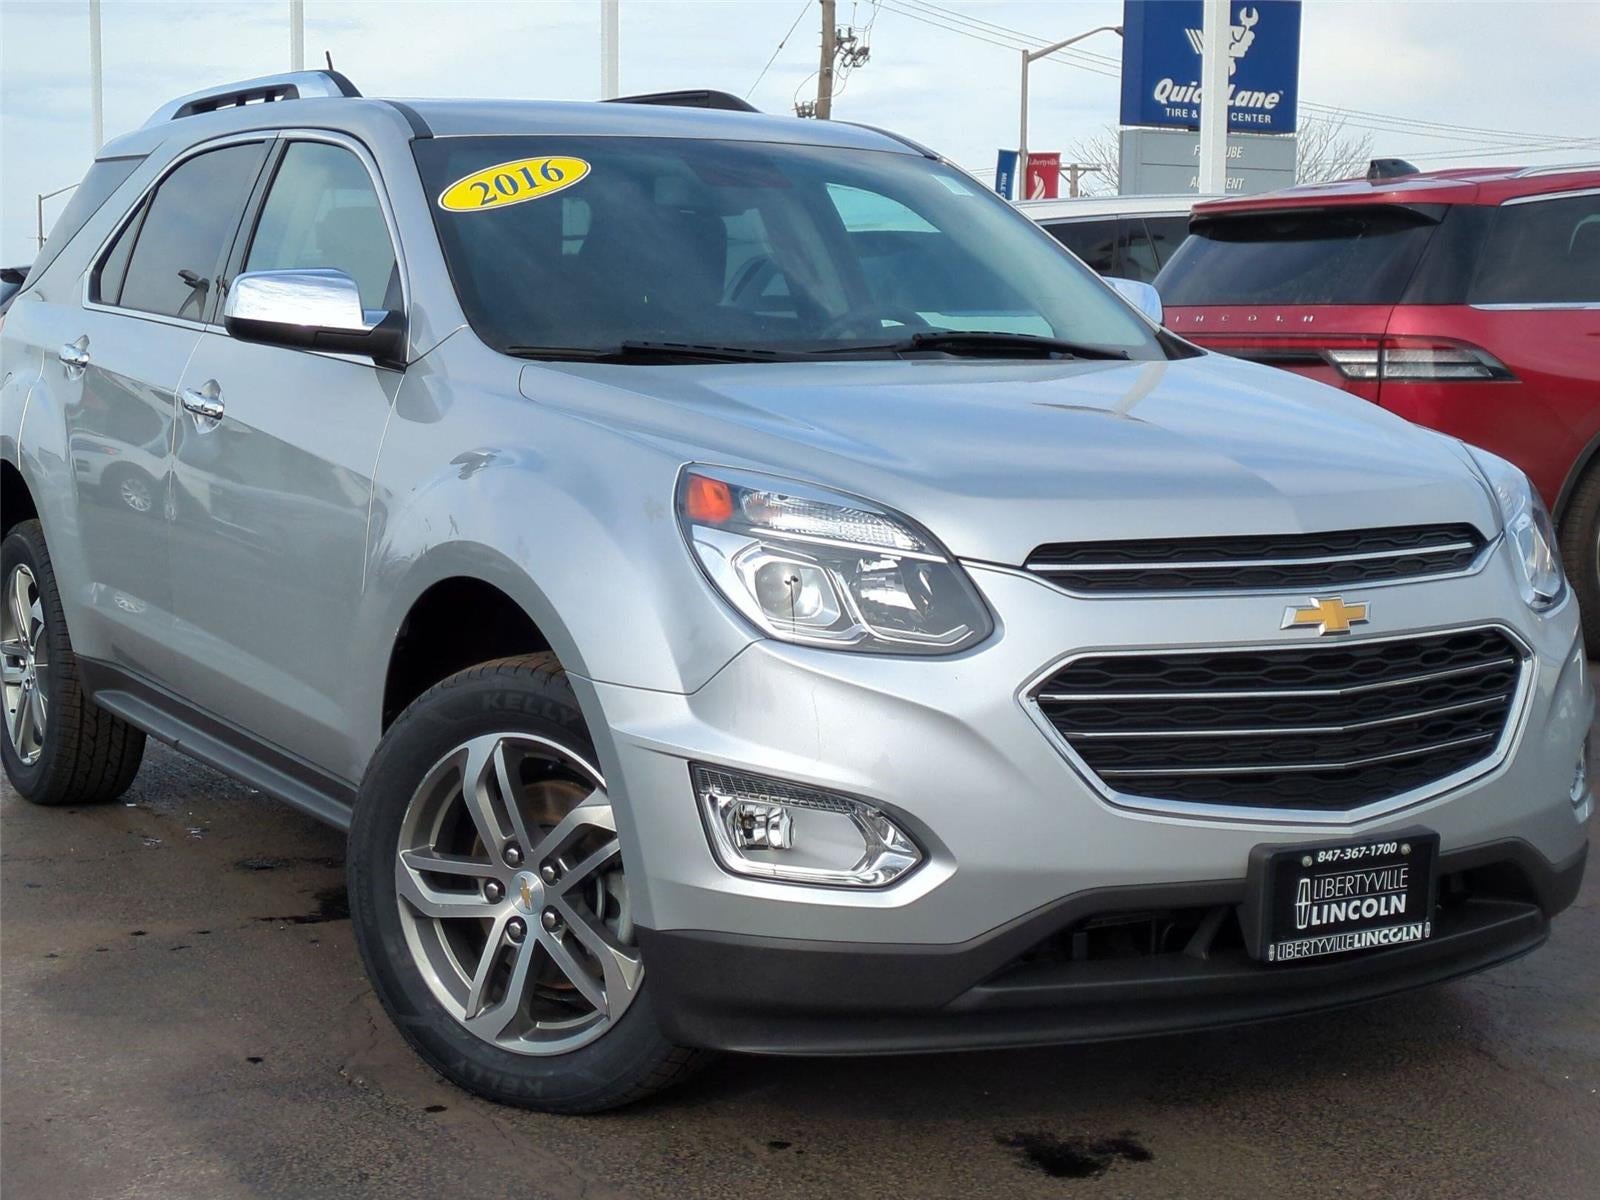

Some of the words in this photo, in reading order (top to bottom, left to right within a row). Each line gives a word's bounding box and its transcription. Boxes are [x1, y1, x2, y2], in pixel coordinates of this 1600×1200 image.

[1154, 78, 1202, 104] Quic
[1227, 84, 1280, 109] Lane
[1166, 107, 1189, 118] TIRE
[1191, 109, 1198, 119] &
[1231, 112, 1272, 124] CENTER
[469, 159, 564, 206] 2016
[1317, 842, 1398, 863] 847-367-1700
[1313, 867, 1409, 900] LIBERTYVILLE
[1311, 893, 1407, 926] LINCOLN
